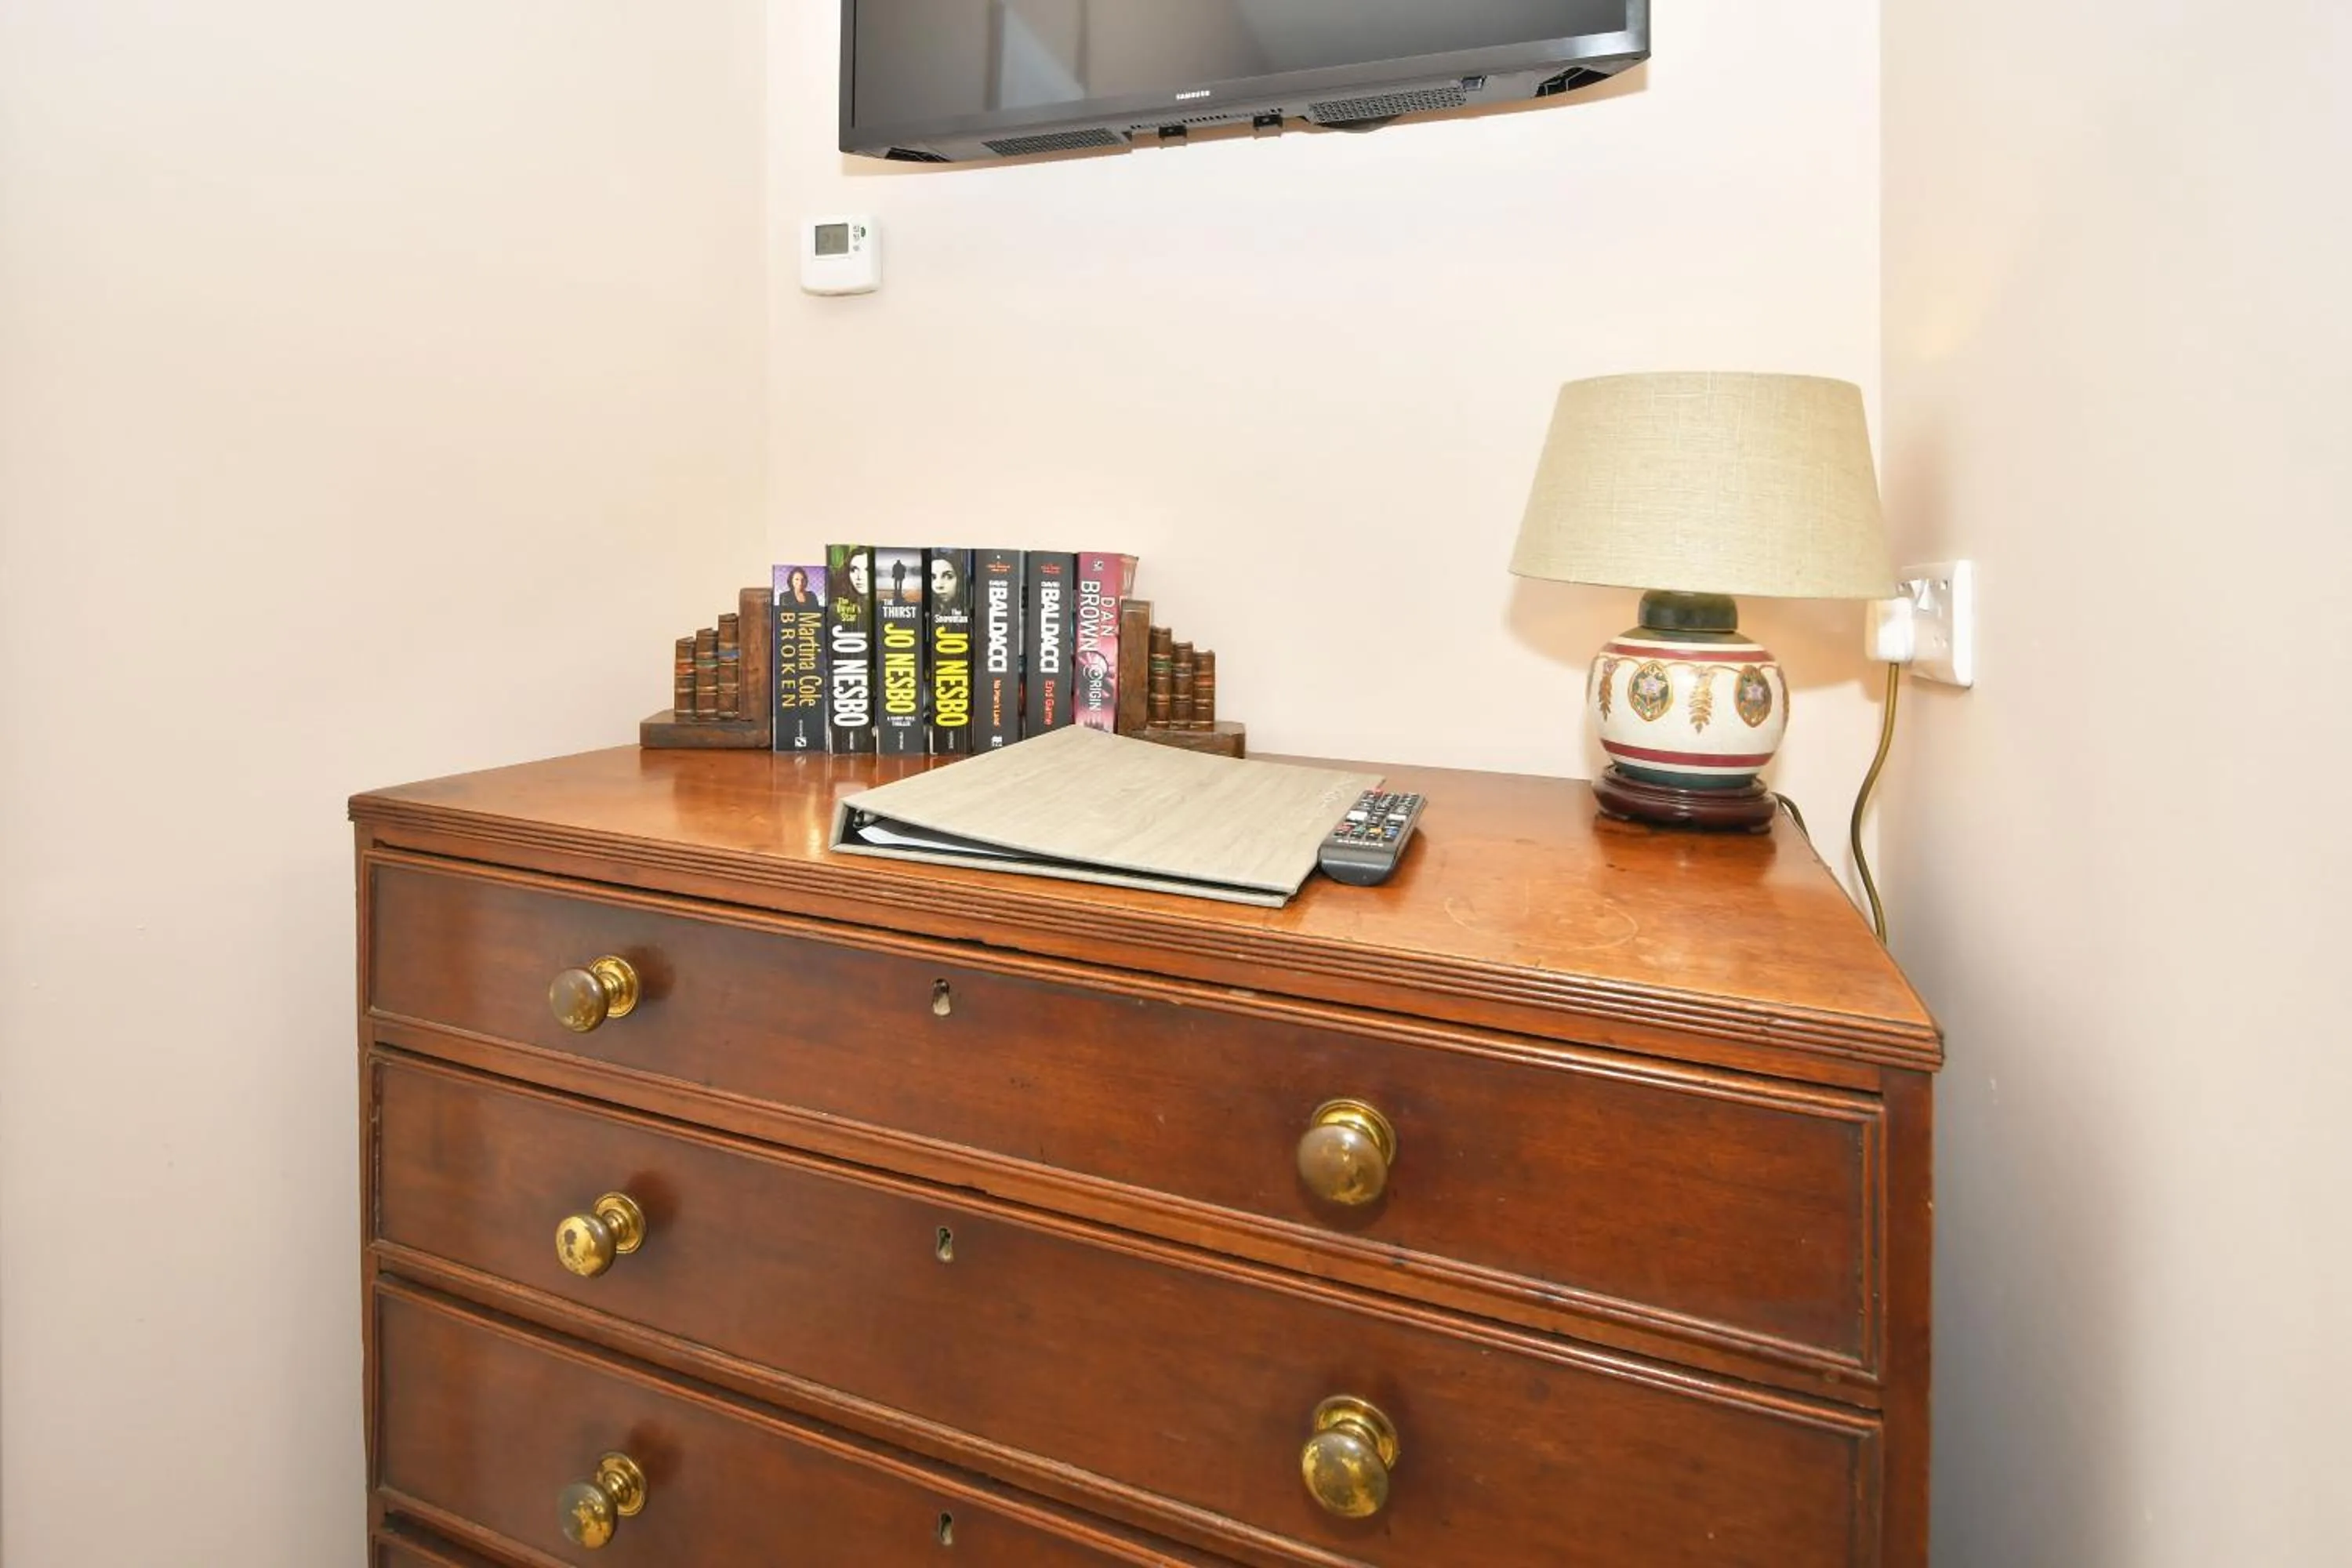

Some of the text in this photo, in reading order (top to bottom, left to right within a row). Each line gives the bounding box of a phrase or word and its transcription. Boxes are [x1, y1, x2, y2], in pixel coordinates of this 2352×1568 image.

[883, 606, 916, 619] THIRST
[935, 614, 968, 623] Snowman
[988, 587, 1008, 673] BALDACCI
[1040, 589, 1060, 673] BALDACCI
[1079, 580, 1101, 652] BROWN
[1100, 597, 1116, 637] DAN
[780, 612, 796, 708] BROKEN
[798, 612, 822, 708] Martina Cole
[832, 625, 869, 727] JO NESBO
[884, 622, 916, 714] JO NESBO
[935, 626, 969, 728] JO NESBO
[1089, 666, 1102, 711] ORIGIN
